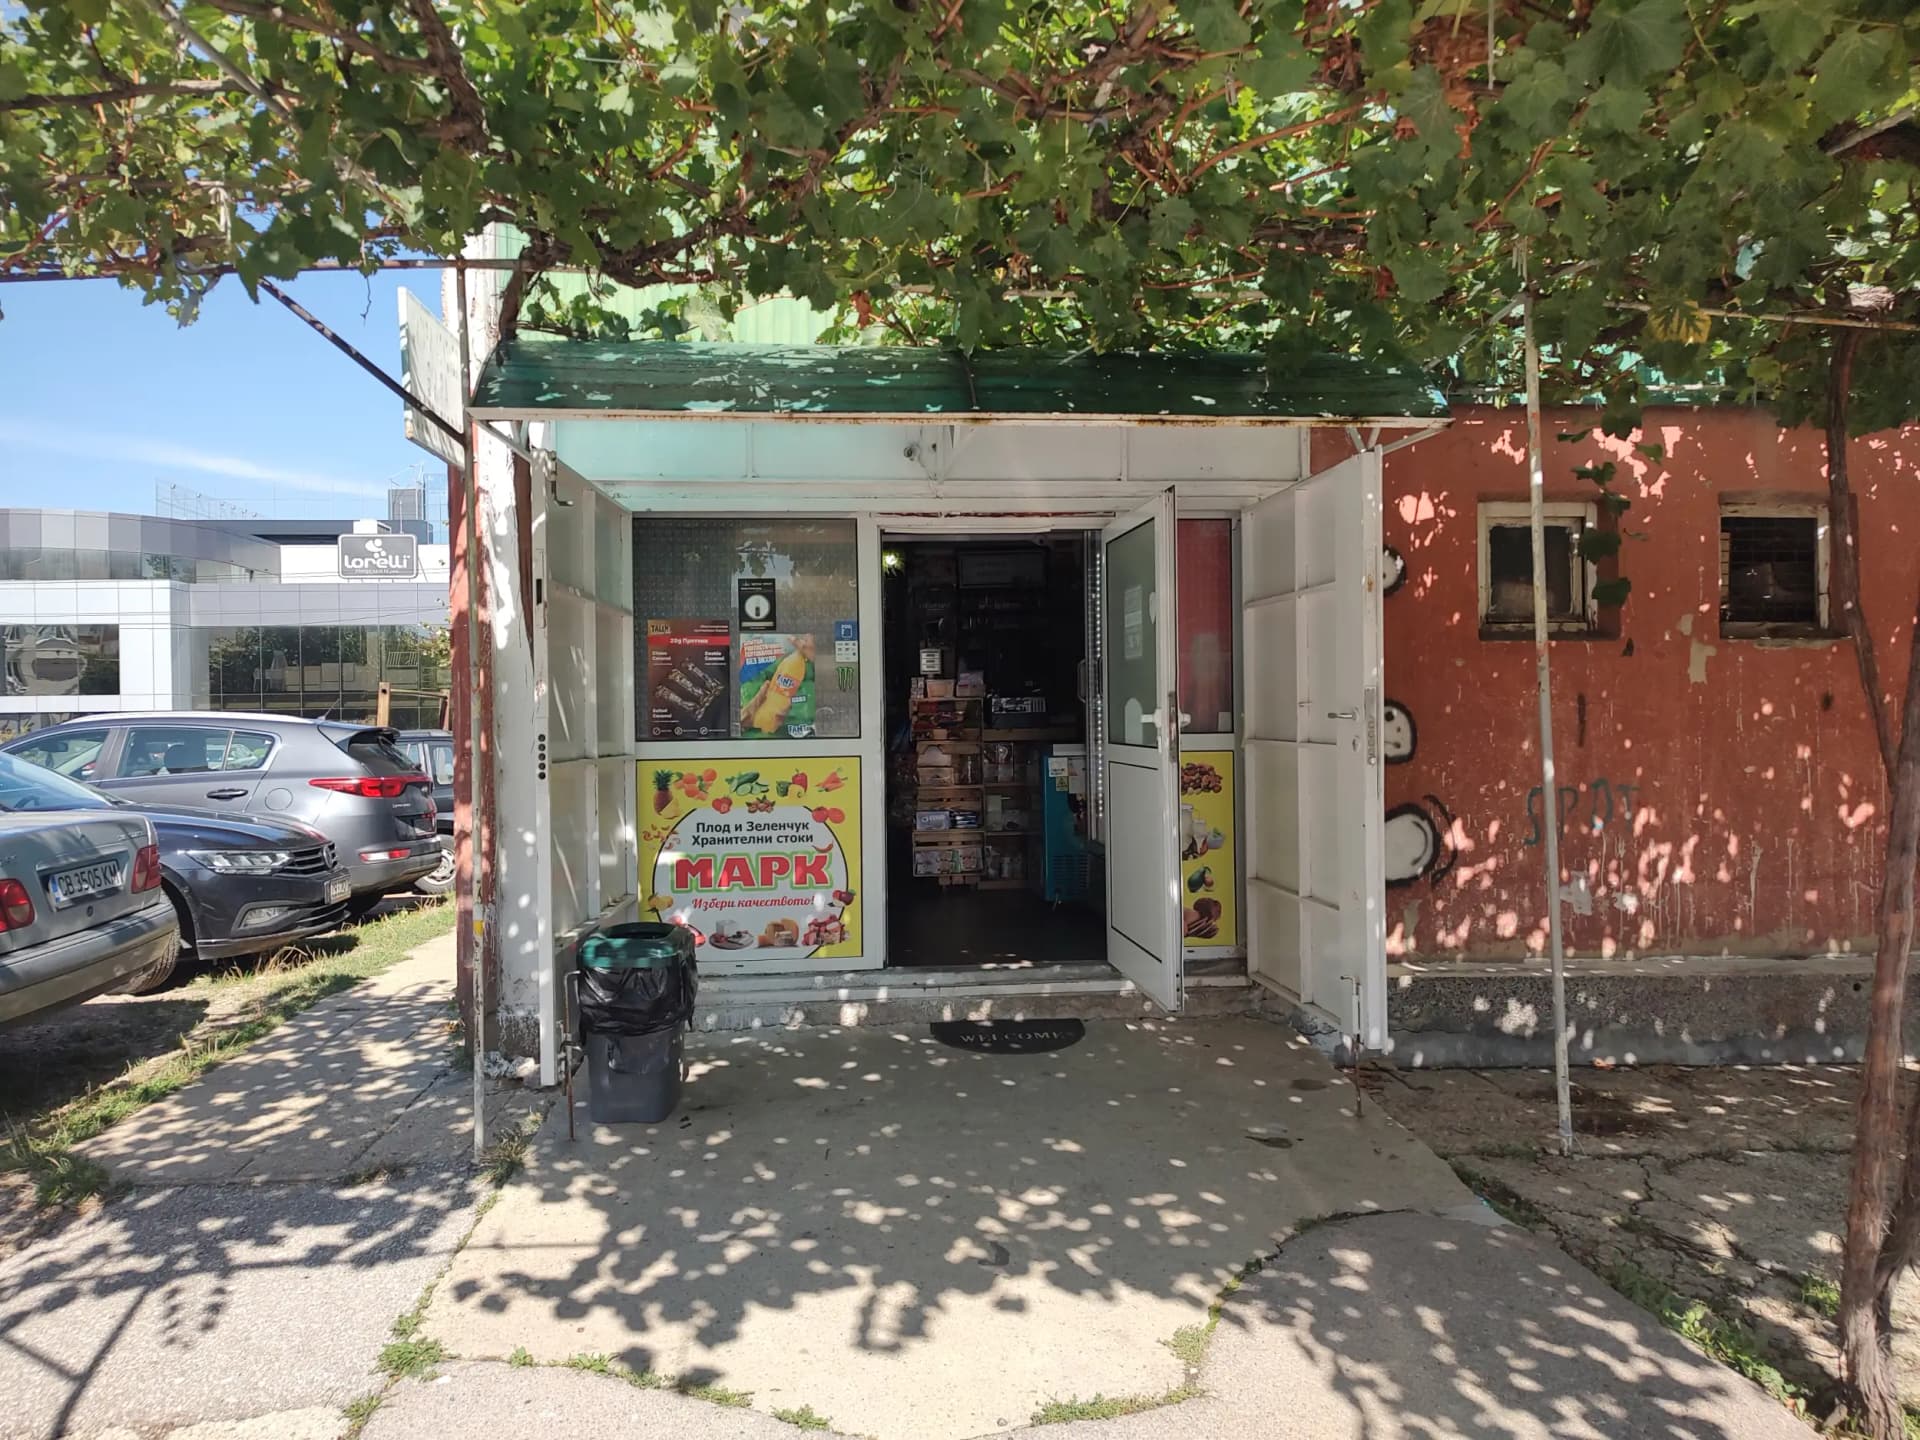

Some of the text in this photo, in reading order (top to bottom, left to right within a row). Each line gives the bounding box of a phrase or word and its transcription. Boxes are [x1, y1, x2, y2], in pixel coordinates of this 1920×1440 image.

[696, 821, 810, 834] Плод и Зеленчук
[692, 834, 814, 848] Хранителни стоки
[672, 853, 831, 891] МАРК
[692, 895, 815, 911] Избери качеството!
